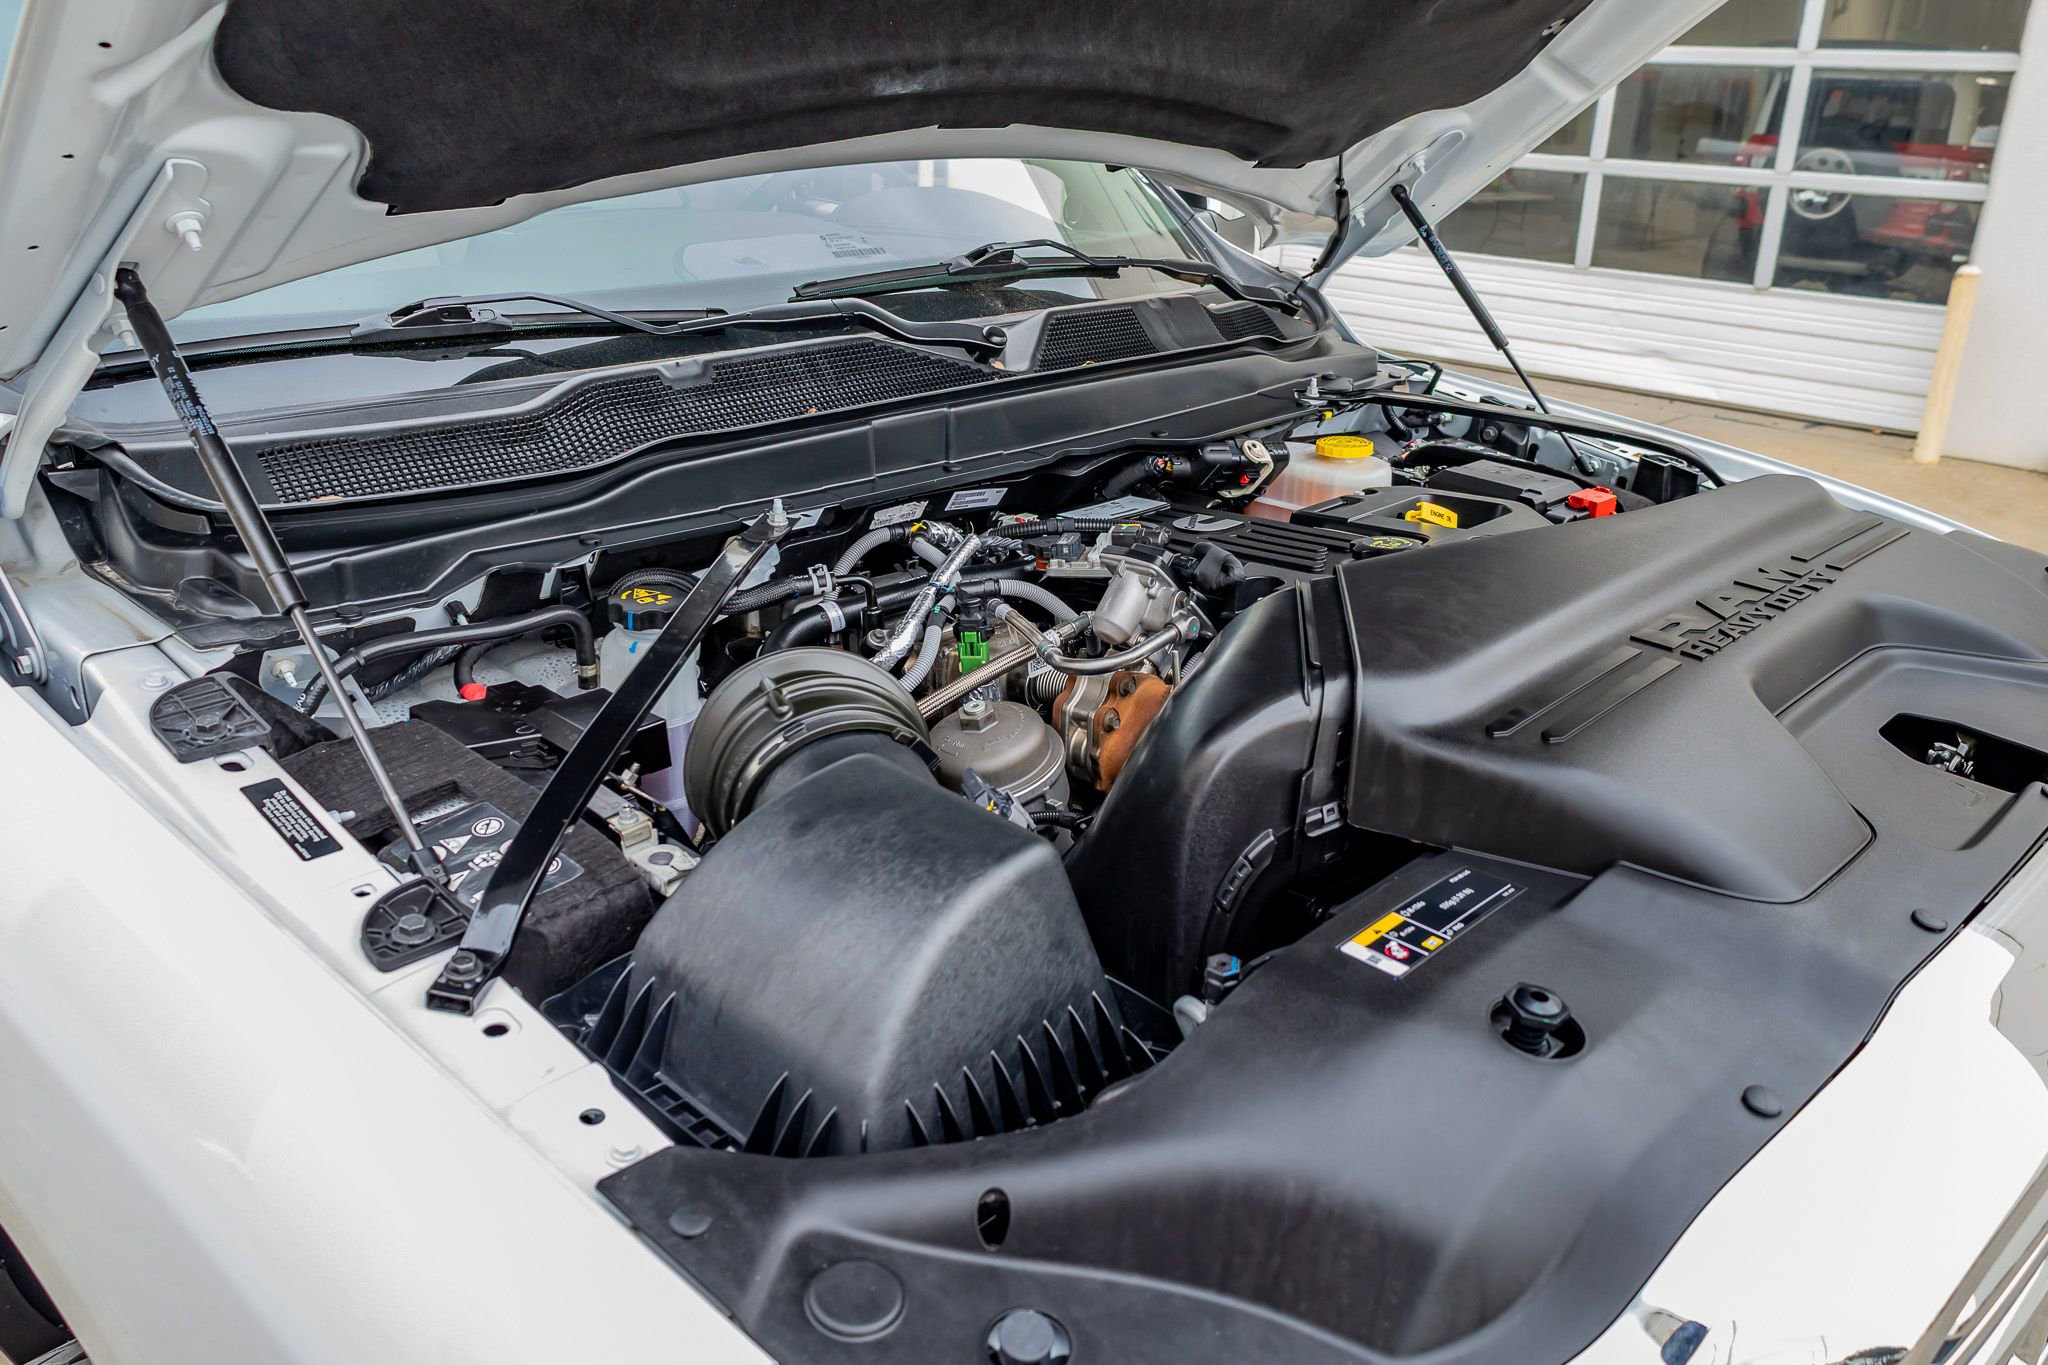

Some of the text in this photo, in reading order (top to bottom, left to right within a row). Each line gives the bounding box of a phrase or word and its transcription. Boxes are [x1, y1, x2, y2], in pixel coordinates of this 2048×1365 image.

[1430, 509, 1445, 520] ENGINE
[1629, 568, 1814, 651] RAM
[1679, 572, 1837, 661] HEAVY DUTY
